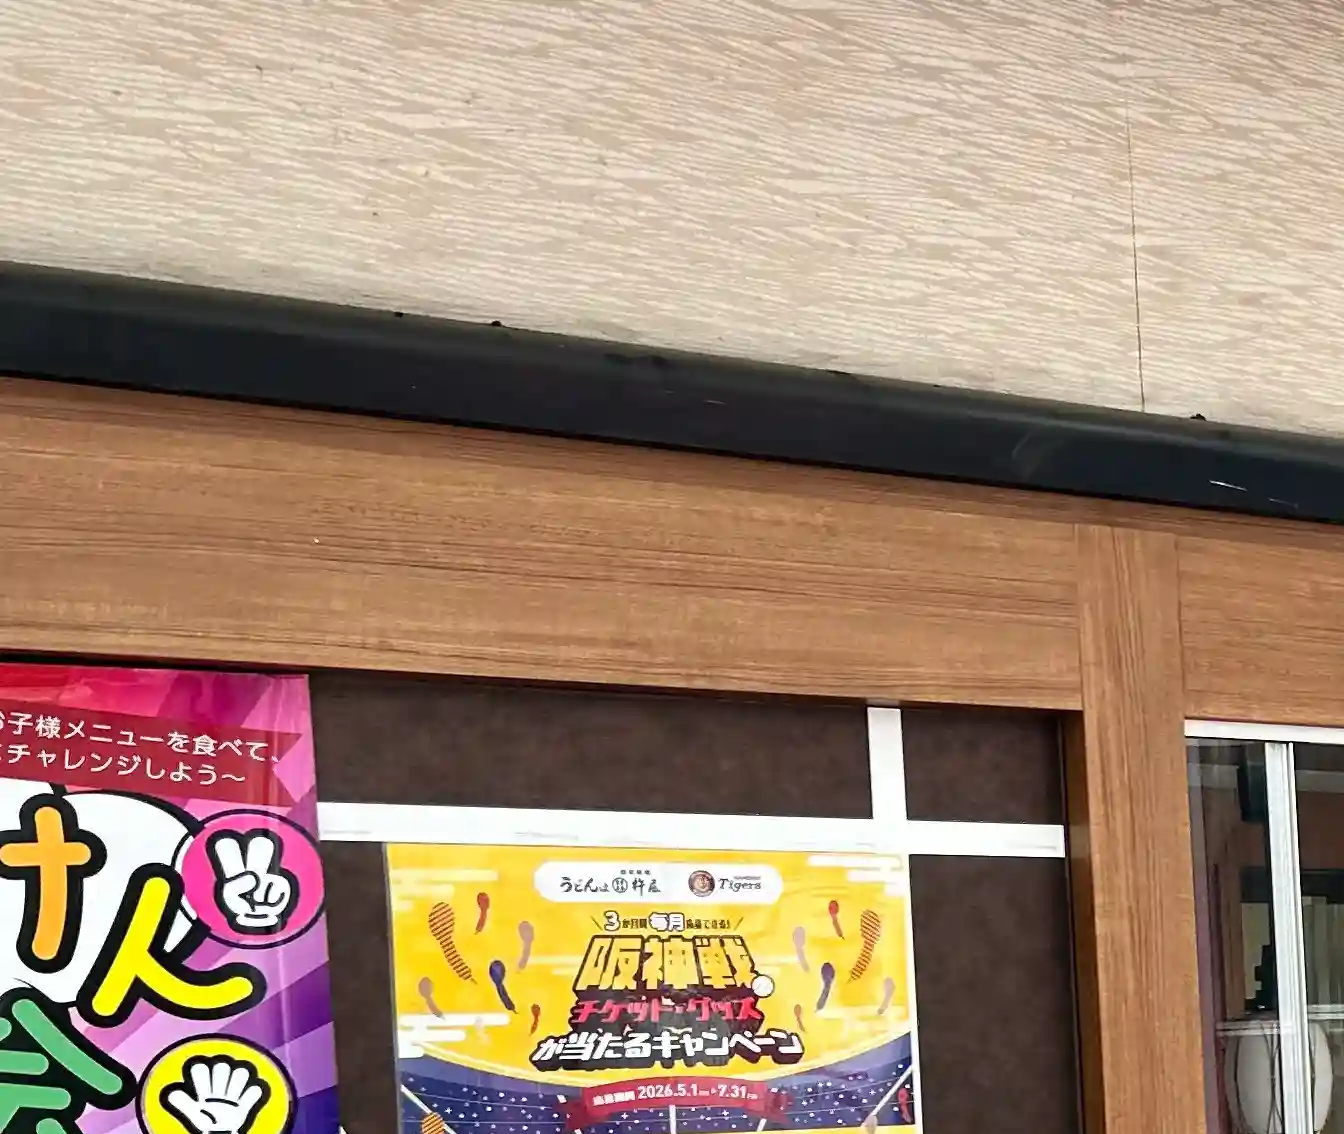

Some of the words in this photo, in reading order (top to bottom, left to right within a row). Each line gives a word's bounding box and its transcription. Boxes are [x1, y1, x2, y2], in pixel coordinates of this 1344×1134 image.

[718, 877, 762, 893] Tigers
[573, 934, 758, 993] 阪神戦
[534, 1027, 804, 1067] が当たるキャンペーン
